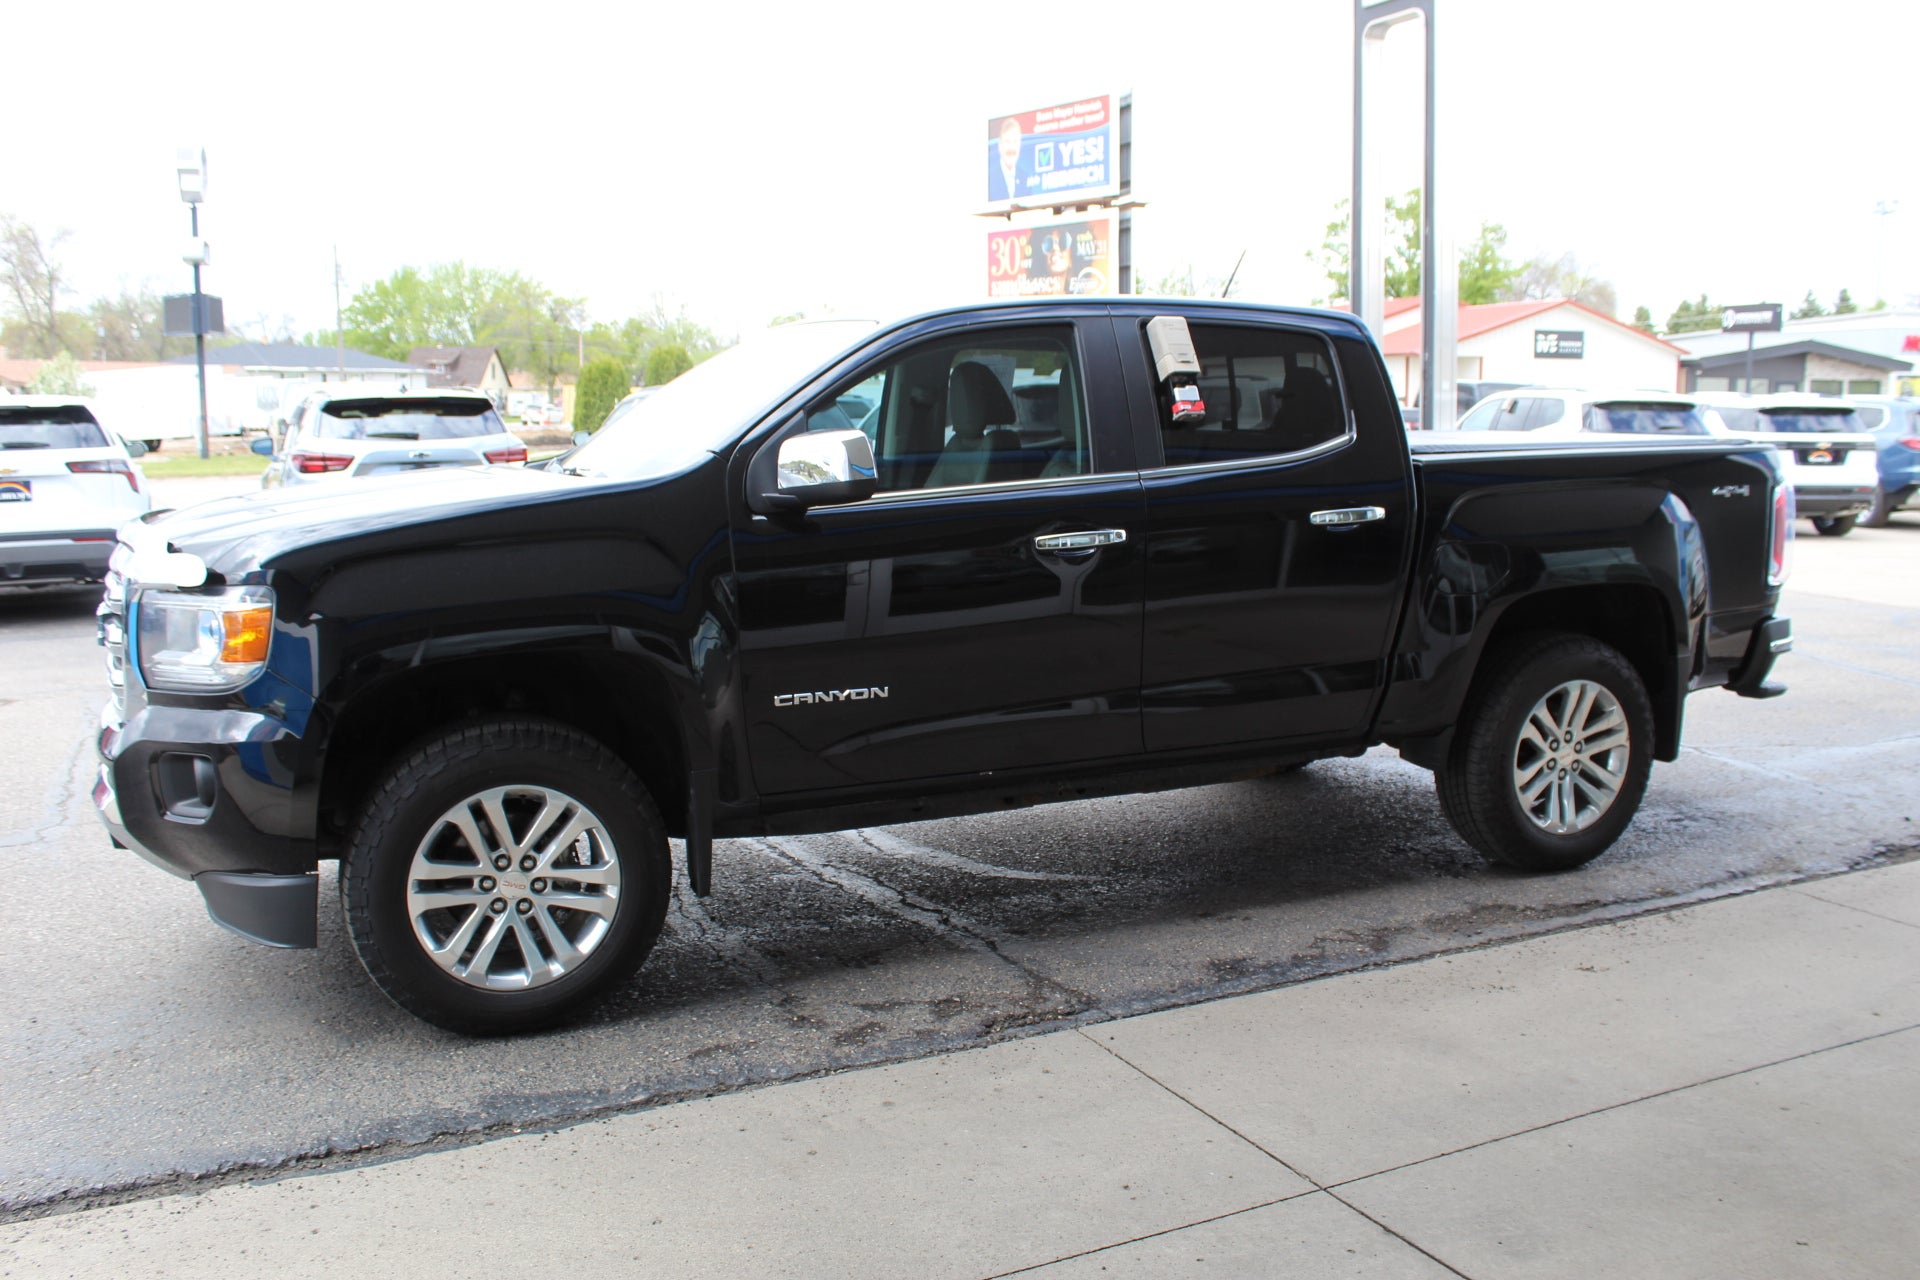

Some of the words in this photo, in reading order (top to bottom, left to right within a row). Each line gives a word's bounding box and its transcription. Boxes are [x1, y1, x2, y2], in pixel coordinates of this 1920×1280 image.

[1058, 136, 1104, 167] YES!
[1077, 240, 1097, 257] MAY
[774, 686, 889, 707] CANYON
[502, 880, 527, 890] GMC
